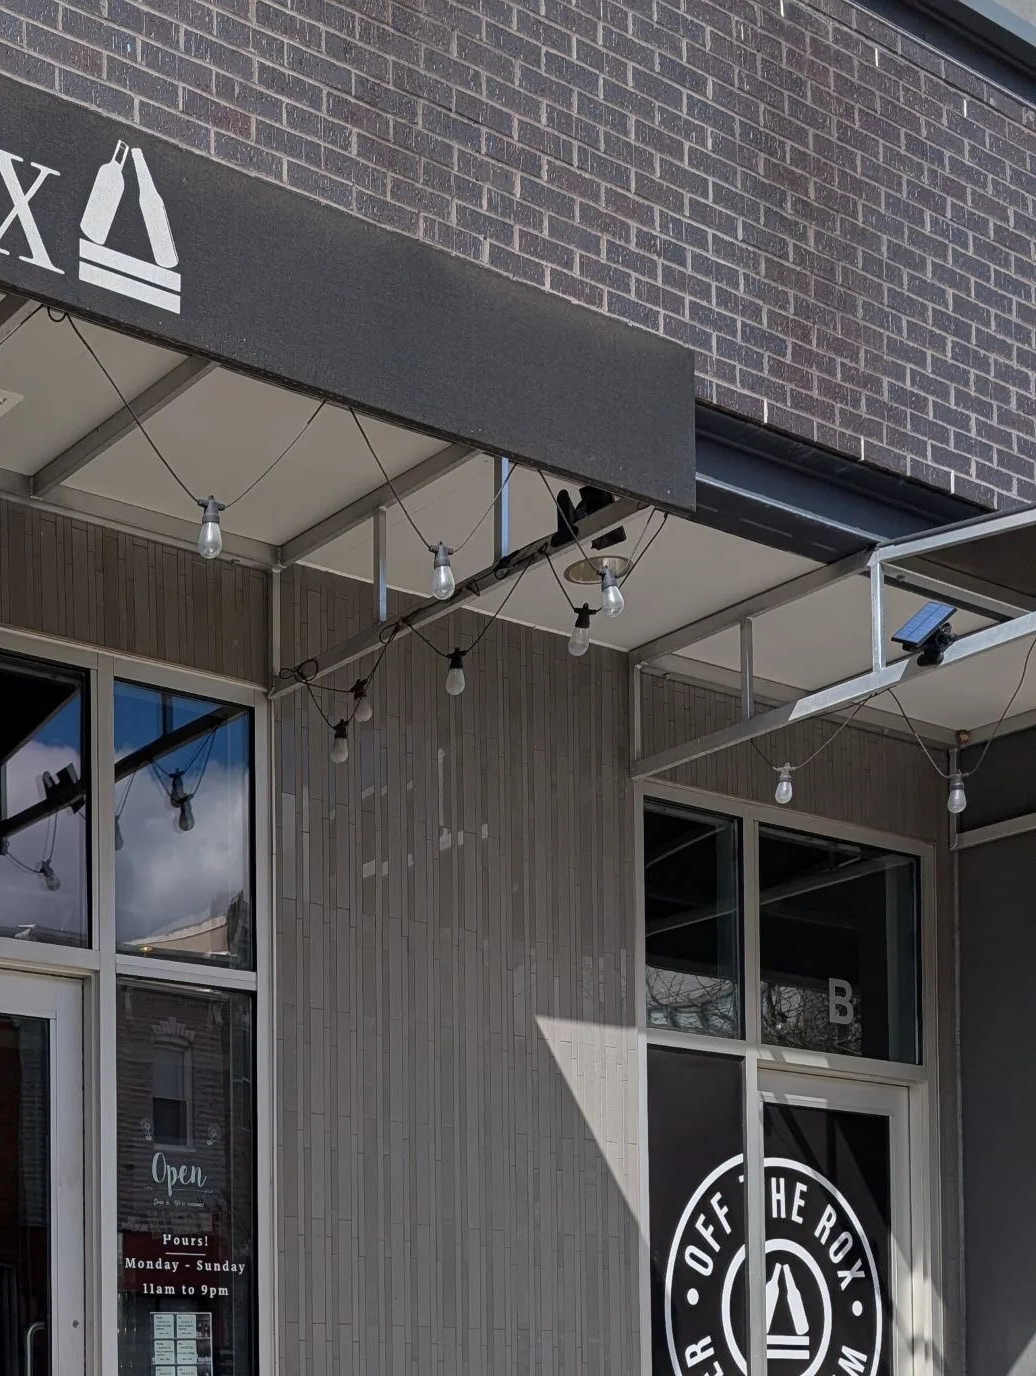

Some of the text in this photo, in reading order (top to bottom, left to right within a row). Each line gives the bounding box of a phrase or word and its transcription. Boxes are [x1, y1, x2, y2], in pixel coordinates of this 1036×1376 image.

[828, 976, 854, 1025] B
[152, 1152, 207, 1196] Open
[684, 1174, 866, 1292] OFF HE ROX
[125, 1257, 179, 1273] Monday
[196, 1259, 245, 1275] Sunday
[143, 1283, 229, 1299] 11am to 9pm
